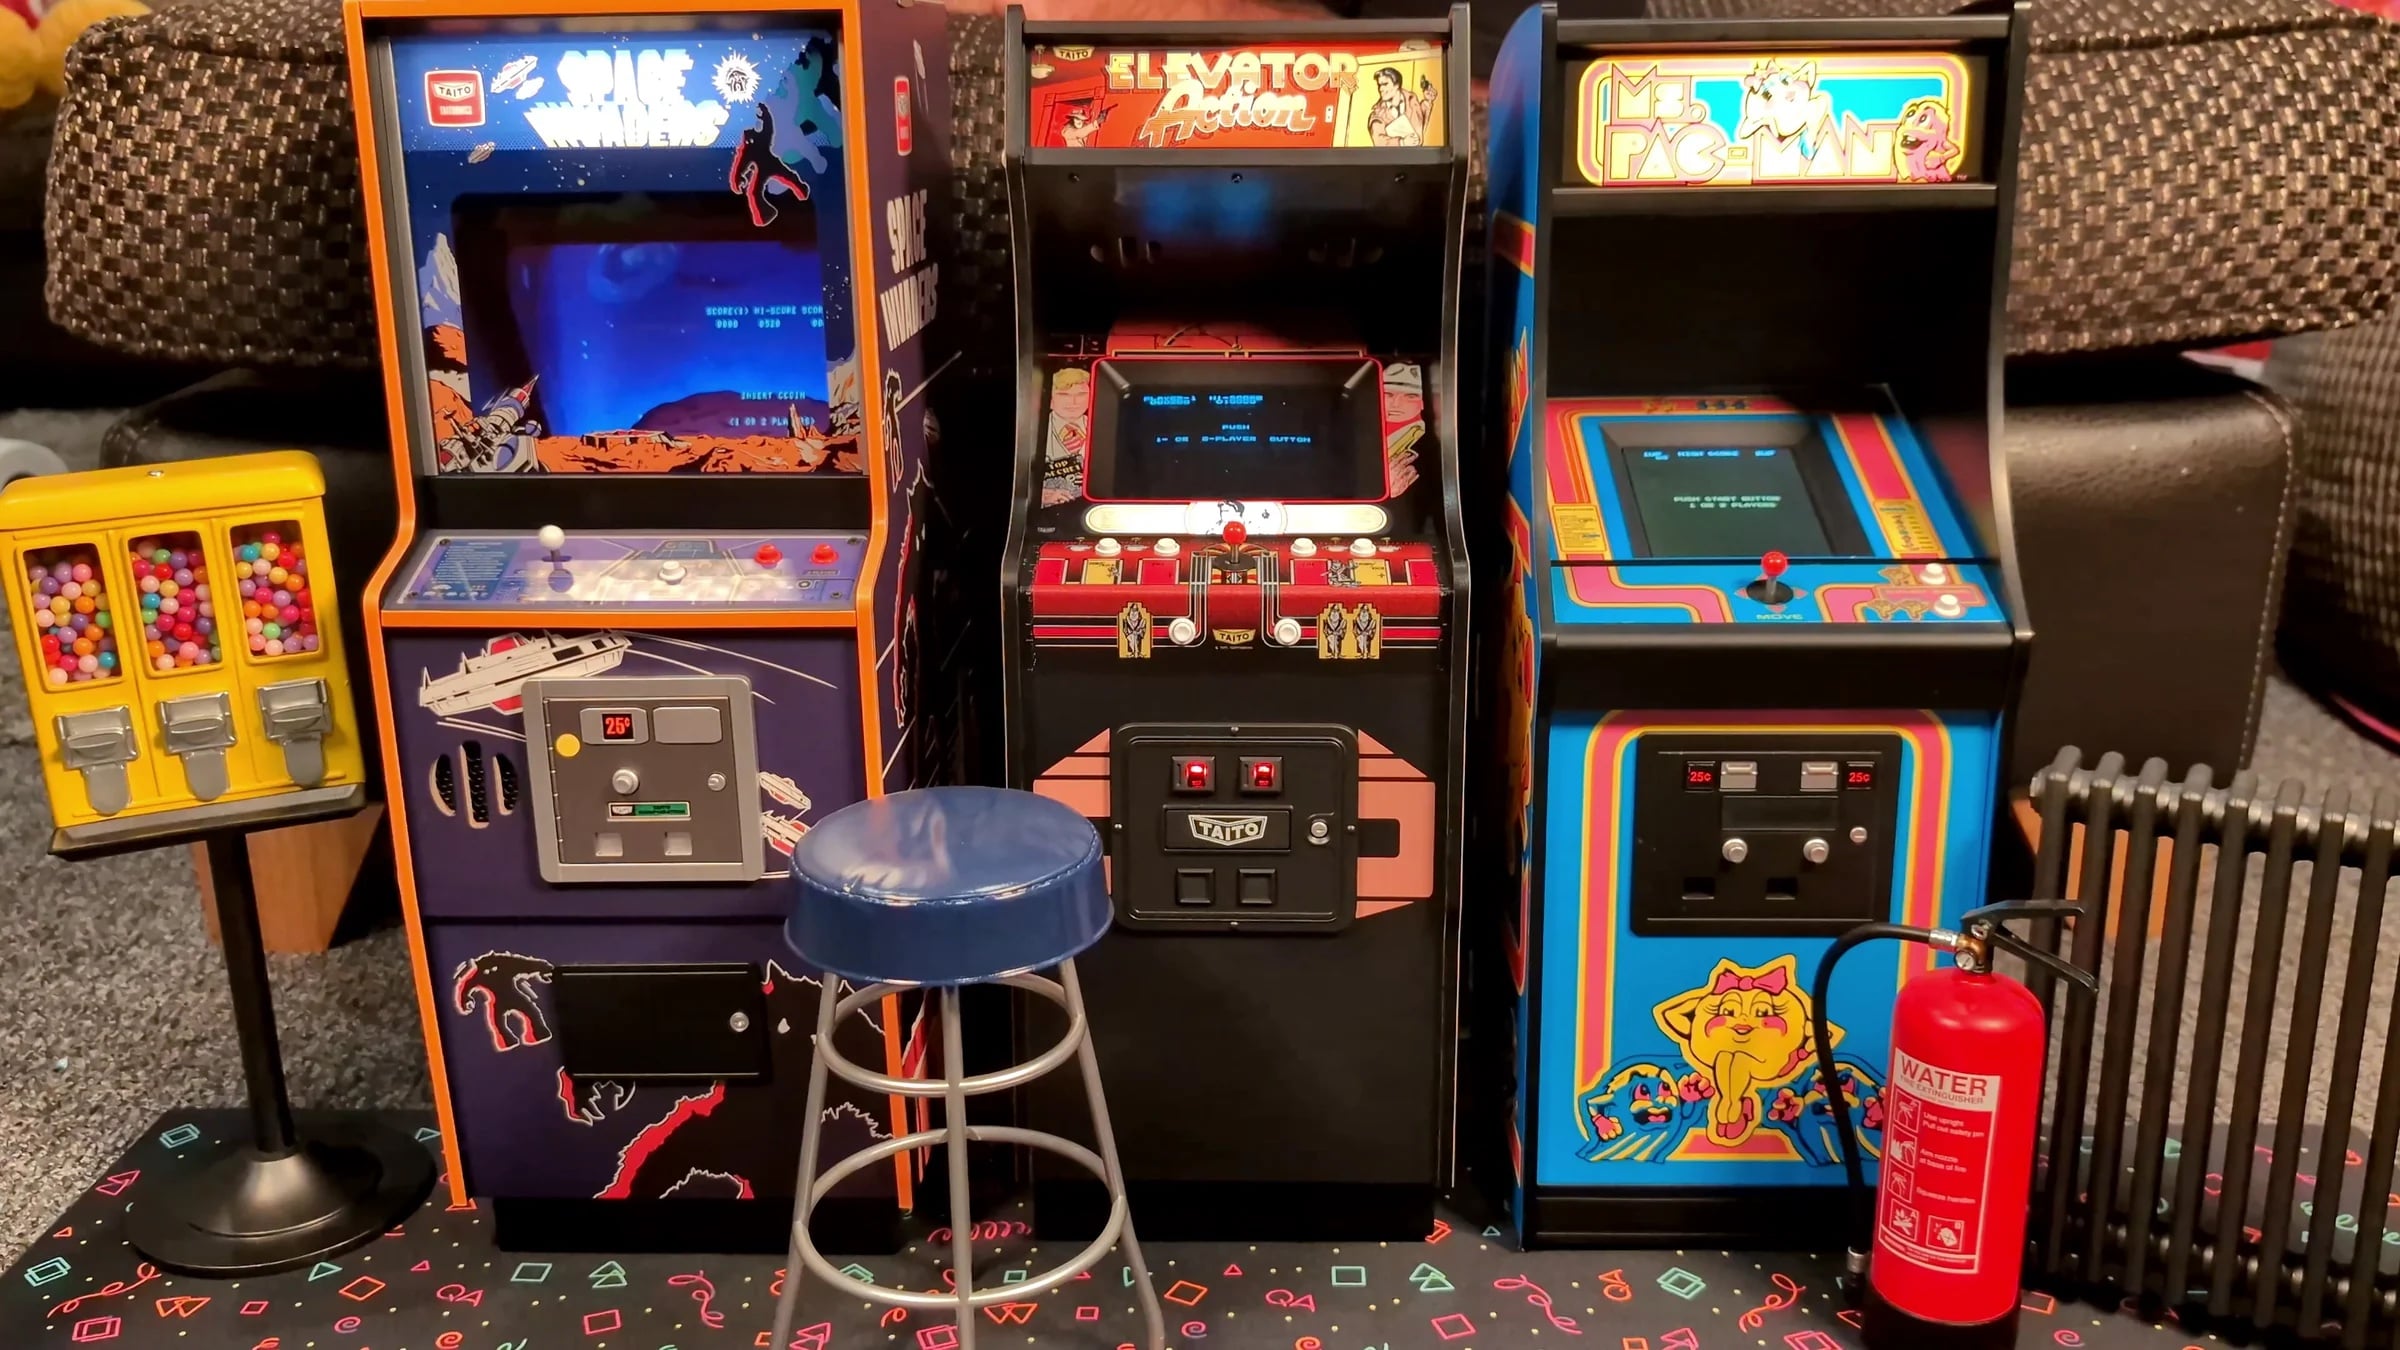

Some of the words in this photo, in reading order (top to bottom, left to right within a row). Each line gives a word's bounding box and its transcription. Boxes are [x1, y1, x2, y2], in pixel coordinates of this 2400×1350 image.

[1060, 50, 1089, 60] TAITO
[557, 49, 694, 105] SPACE
[1106, 52, 1359, 92] ELEVATOR
[438, 86, 471, 97] TAITO
[1140, 79, 1316, 147] Action
[523, 100, 730, 148] INVADERS
[1602, 114, 1899, 187] PAC-MAN
[887, 188, 928, 275] SPACE
[754, 305, 797, 315] HI-SCORE
[880, 262, 939, 352] INVADERS
[741, 391, 772, 400] INSERT
[1044, 464, 1081, 478] SECRET
[1049, 460, 1069, 470] TOP
[1219, 632, 1250, 642] TAITO
[1690, 771, 1712, 783] 25¢
[1848, 772, 1871, 783] 25¢
[1198, 822, 1259, 841] TAITO
[1901, 1055, 1988, 1097] WATER
[1916, 1083, 1985, 1105] EXTINGUISHER
[1922, 1120, 1937, 1131] Pull
[1936, 1125, 1949, 1133] out
[1949, 1128, 1972, 1138] safety
